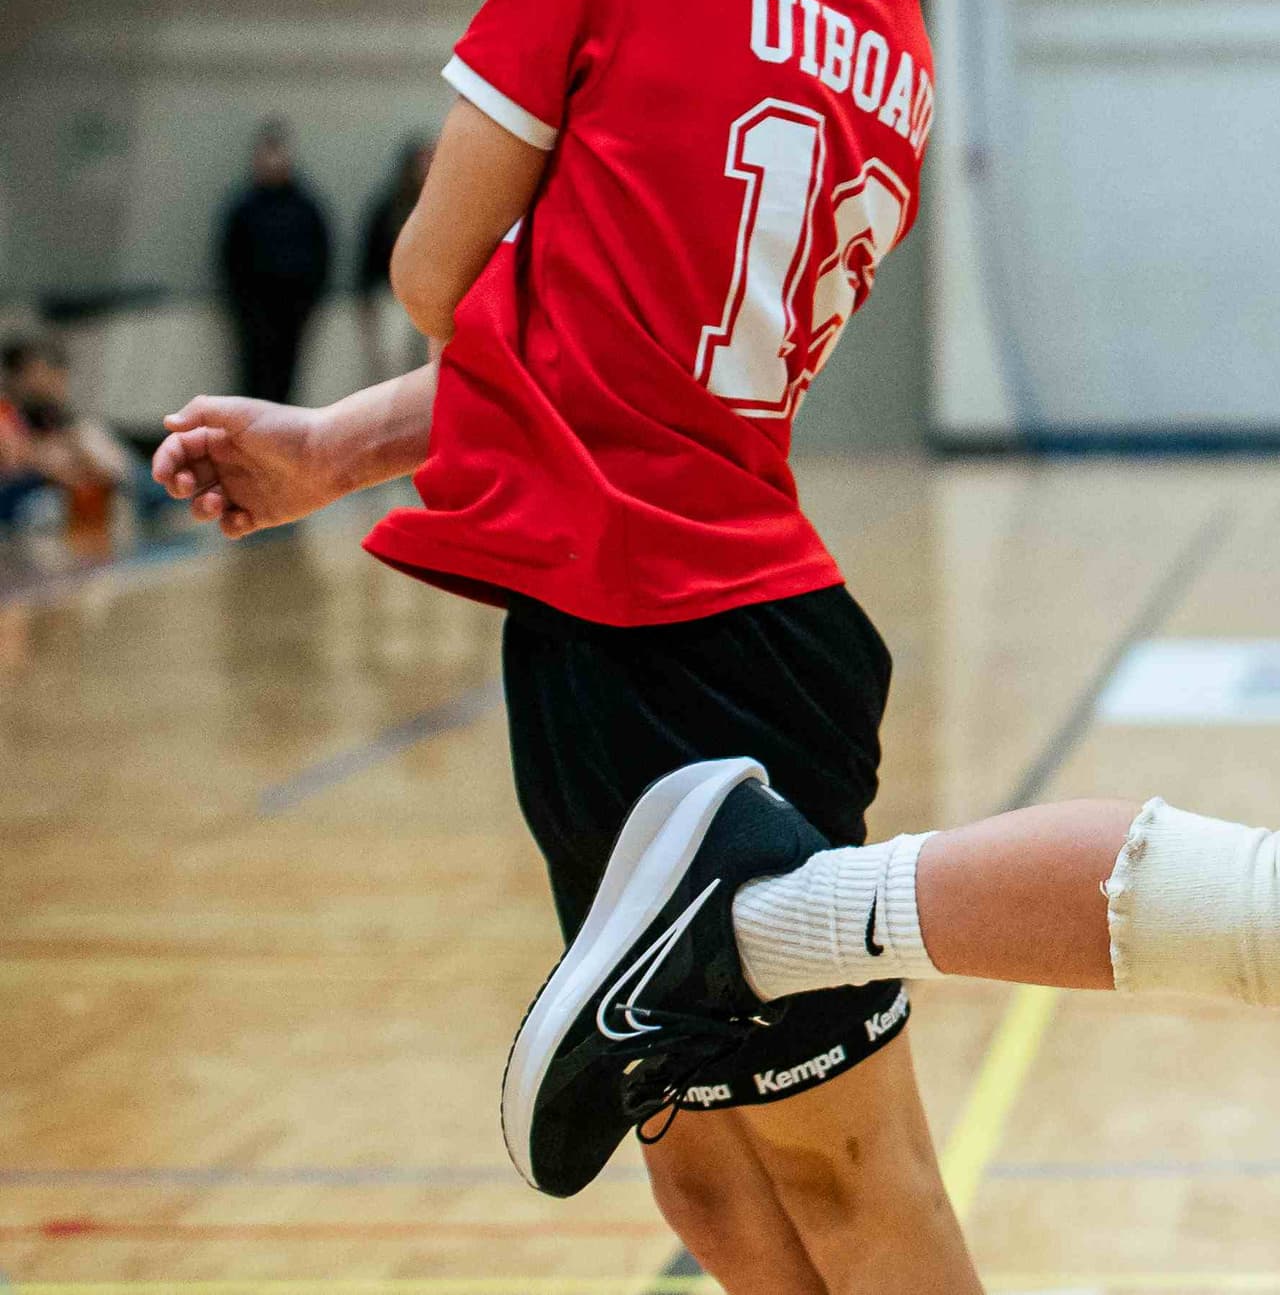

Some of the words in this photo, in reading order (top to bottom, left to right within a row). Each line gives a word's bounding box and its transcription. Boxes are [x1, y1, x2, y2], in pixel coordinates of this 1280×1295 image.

[864, 985, 910, 1043] Kemp
[664, 1083, 732, 1108] mpa
[752, 1043, 848, 1096] Kempa
